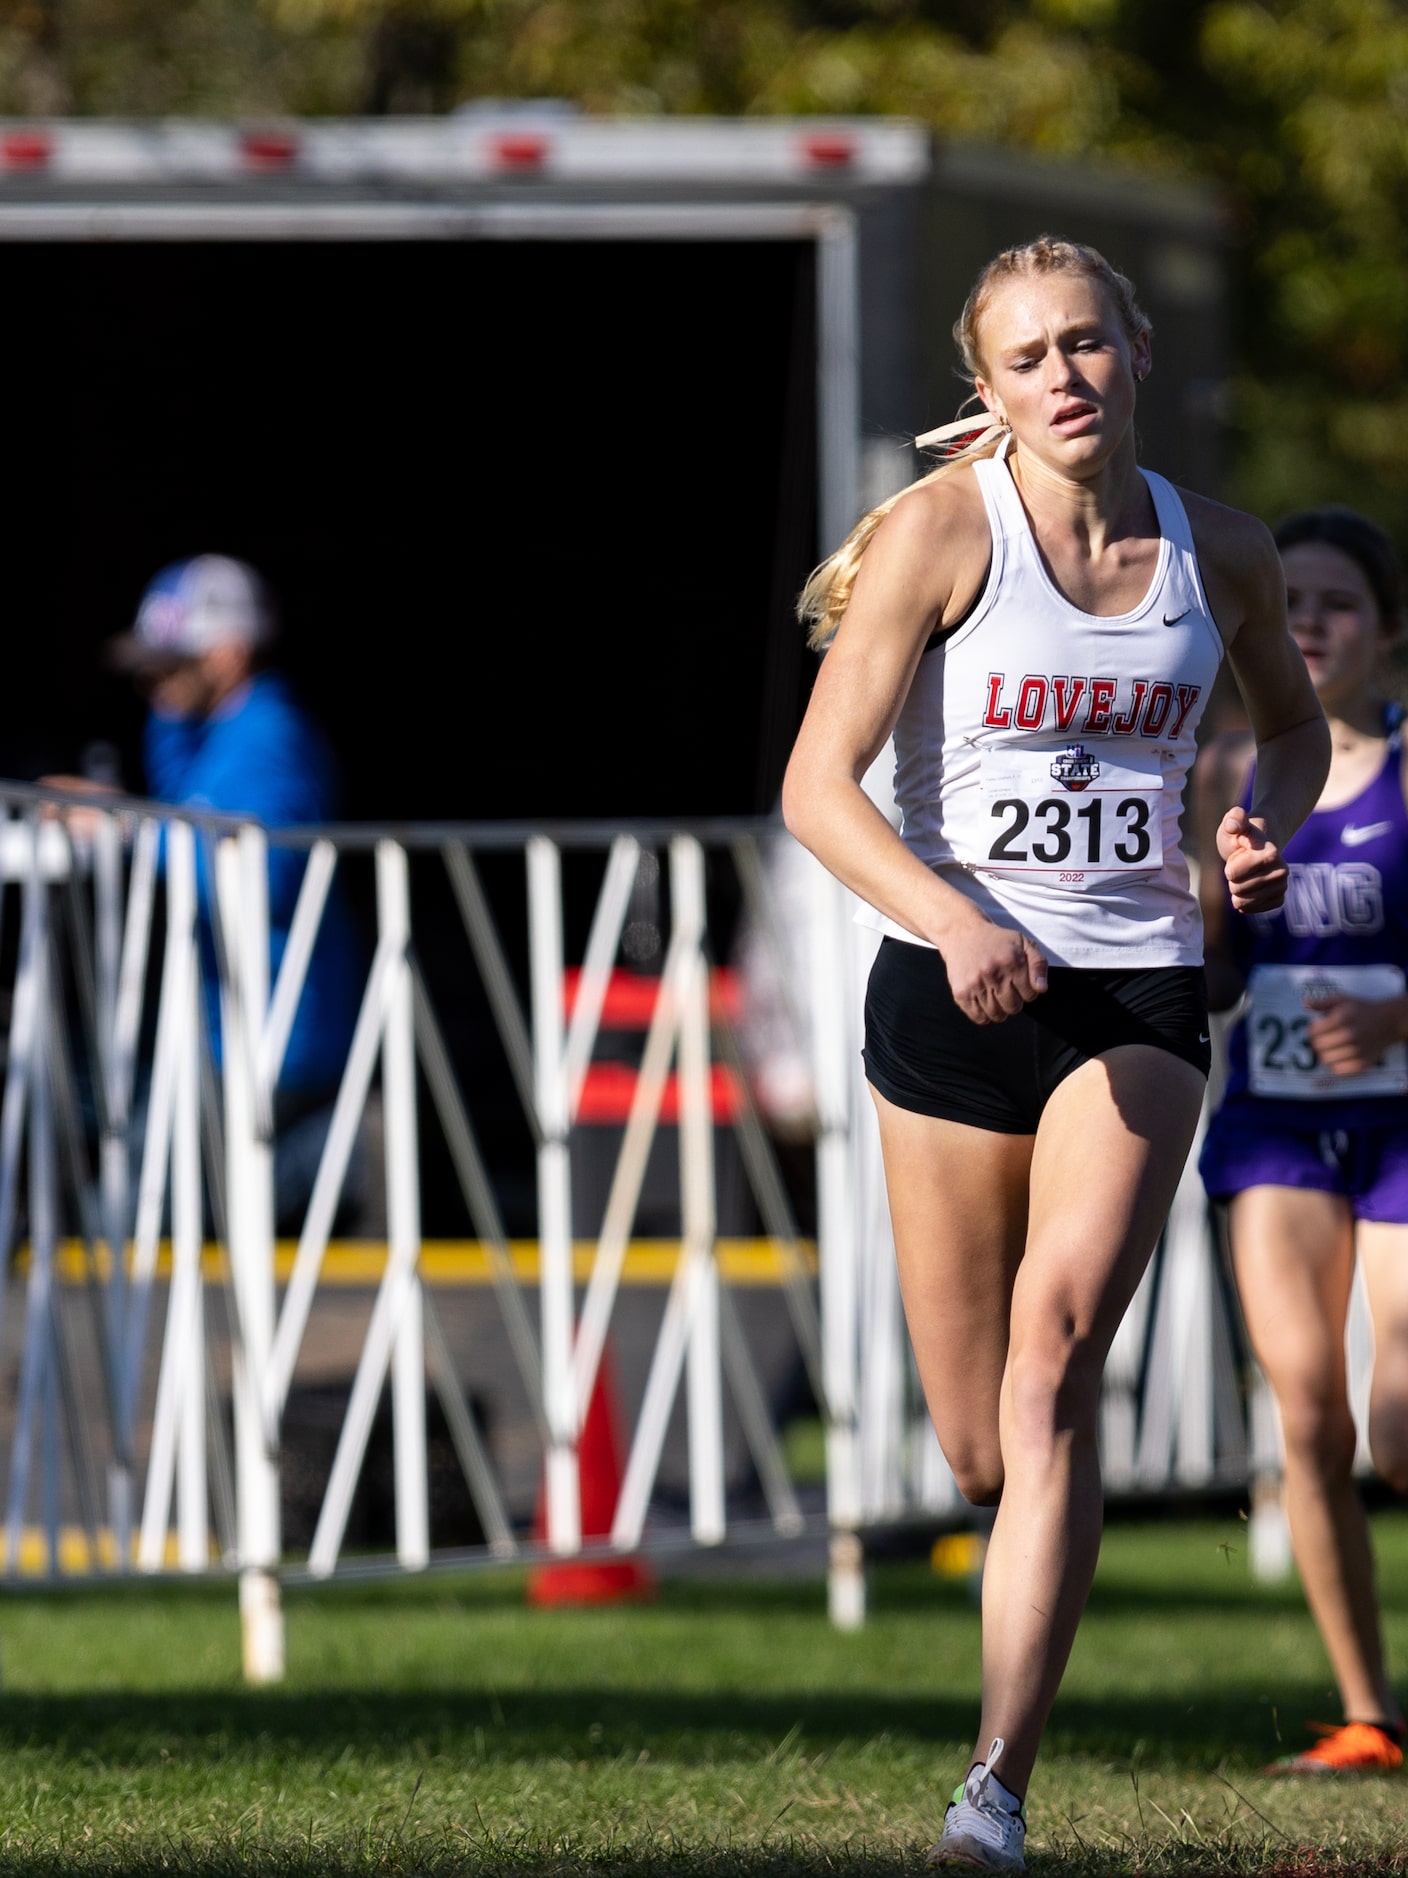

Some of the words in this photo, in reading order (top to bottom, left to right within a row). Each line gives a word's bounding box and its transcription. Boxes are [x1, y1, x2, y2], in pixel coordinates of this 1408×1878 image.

[982, 673, 1201, 739] LOVEJOY
[1051, 763, 1099, 776] STATE
[988, 798, 1151, 863] 2313
[1059, 872, 1085, 882] 2022
[1248, 862, 1384, 938] NG
